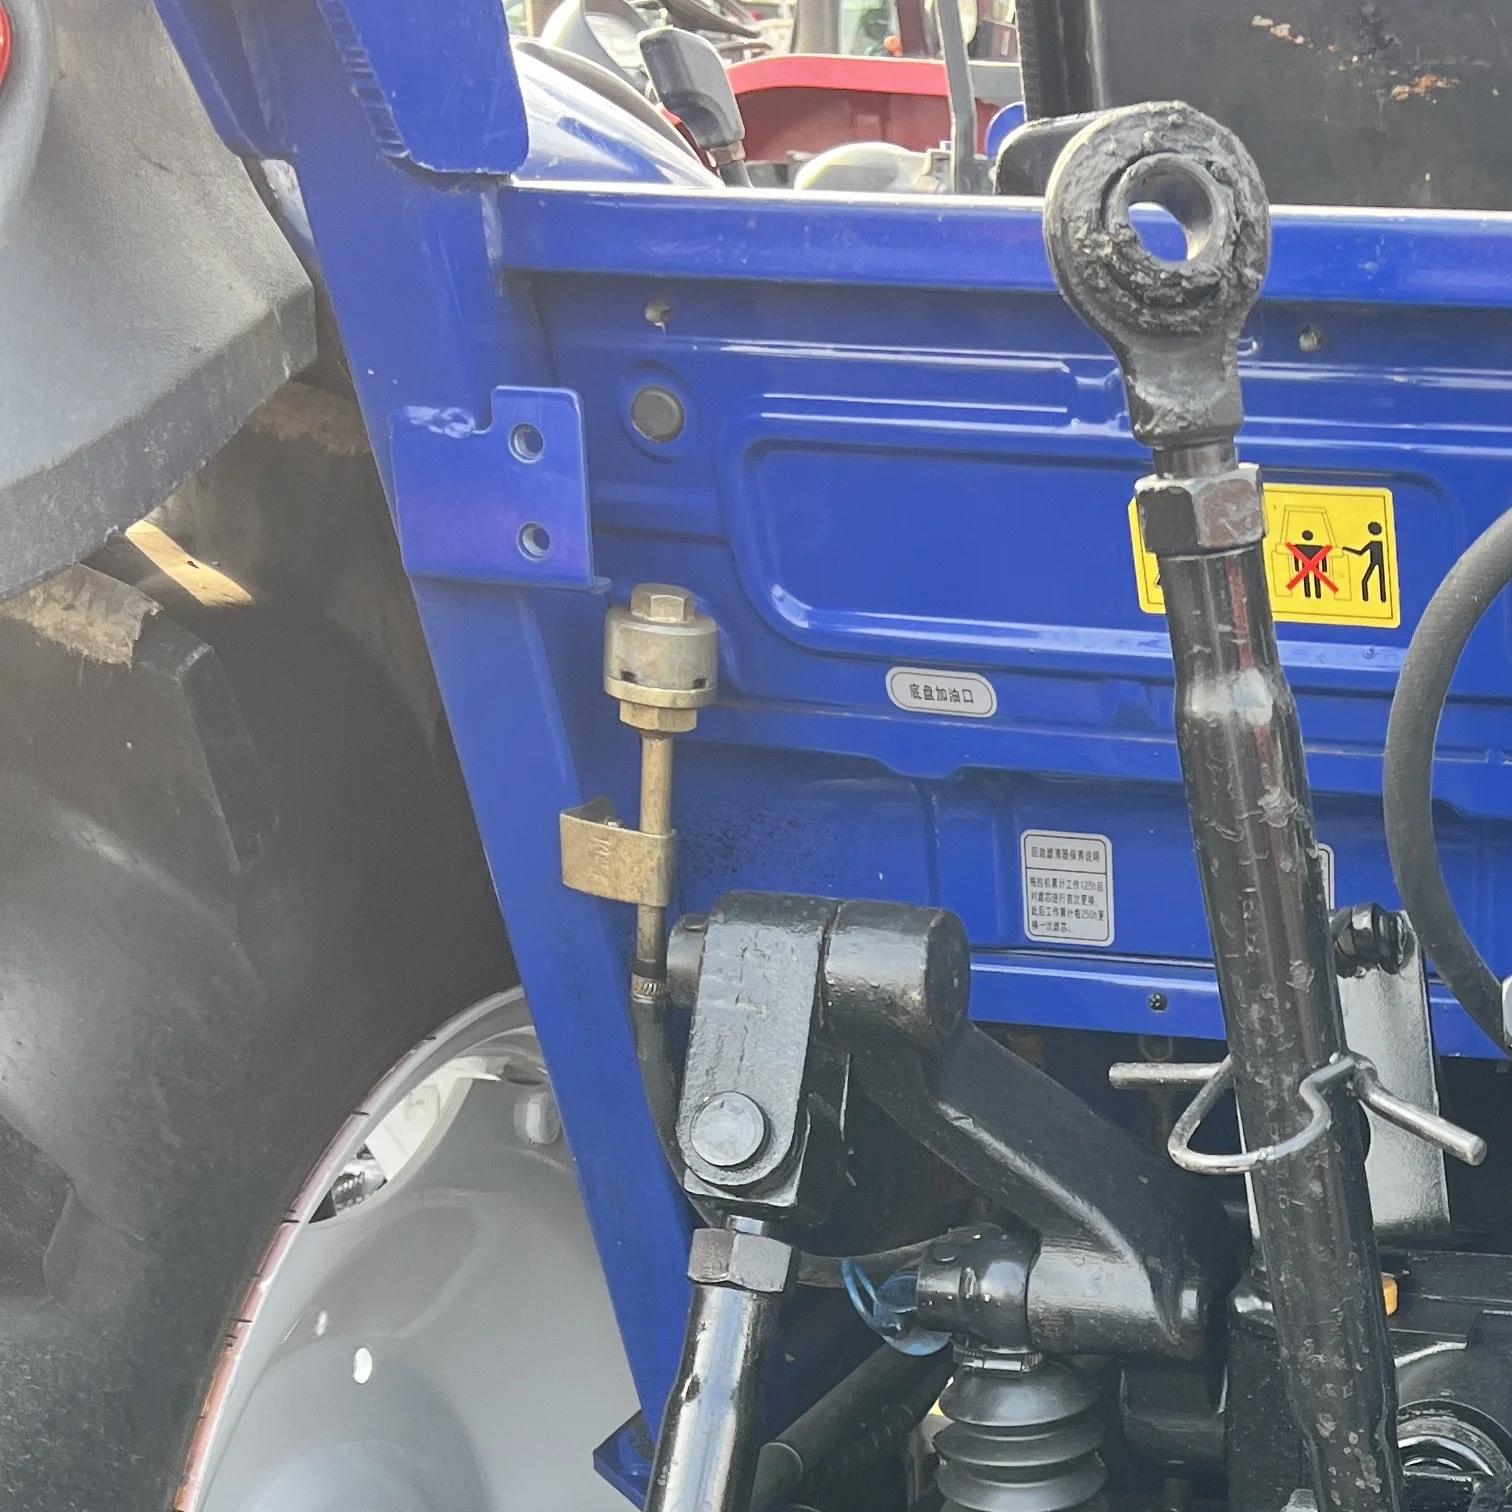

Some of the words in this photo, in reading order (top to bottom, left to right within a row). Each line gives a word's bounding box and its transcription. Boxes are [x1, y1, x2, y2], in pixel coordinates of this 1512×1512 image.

[909, 683, 974, 703] 底盘加油口
